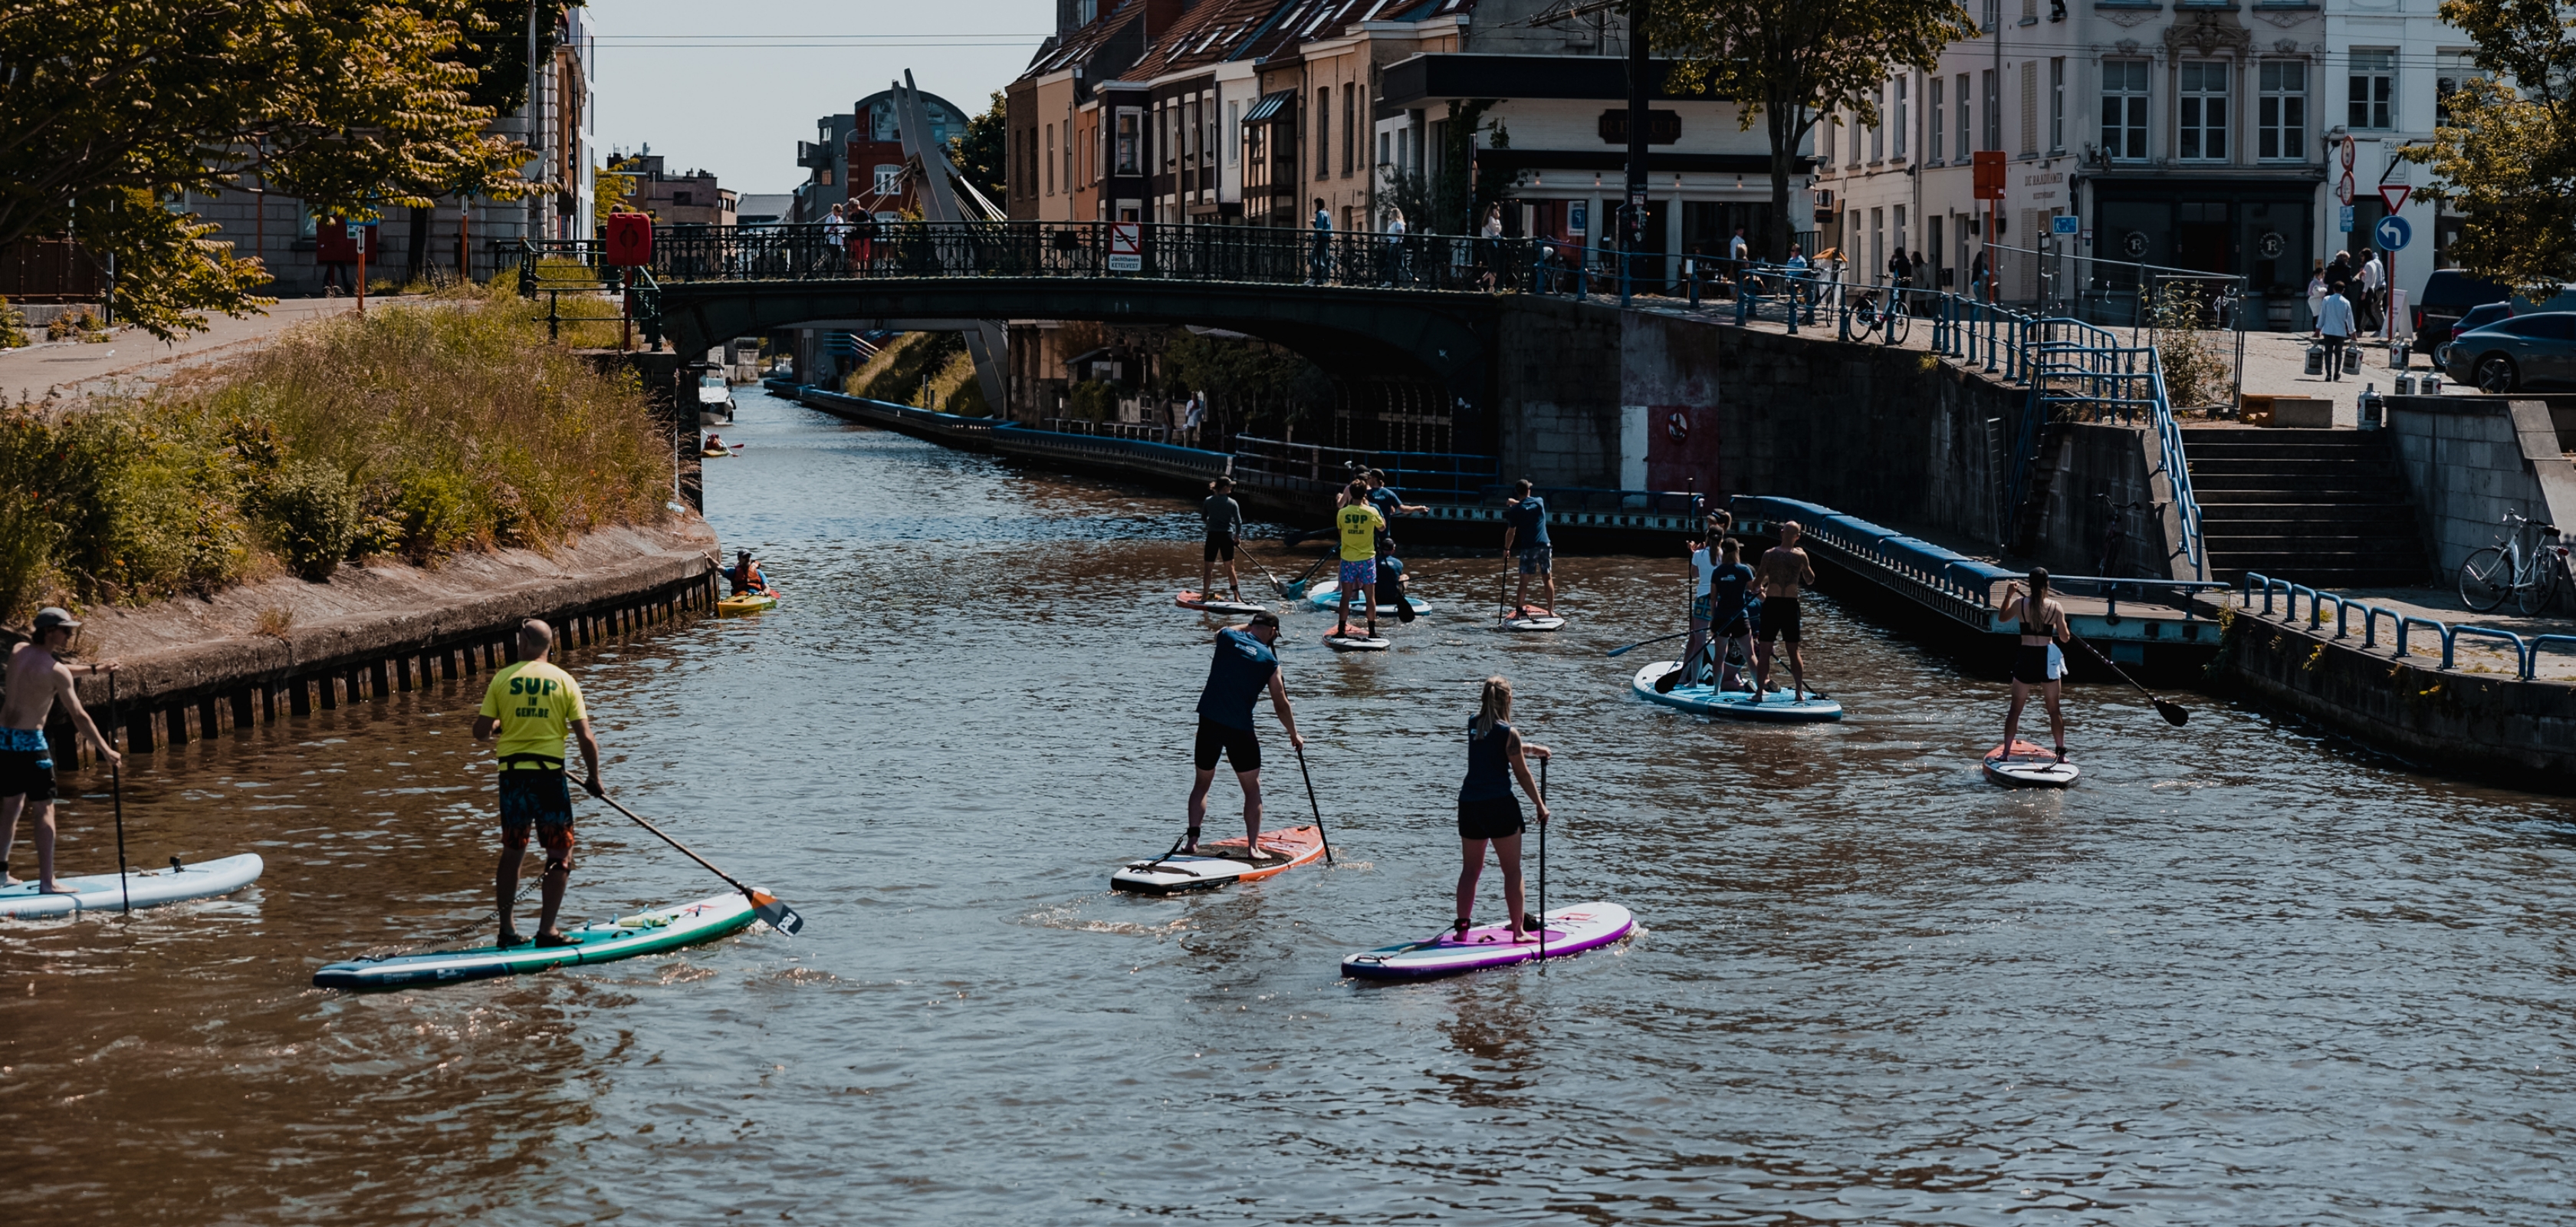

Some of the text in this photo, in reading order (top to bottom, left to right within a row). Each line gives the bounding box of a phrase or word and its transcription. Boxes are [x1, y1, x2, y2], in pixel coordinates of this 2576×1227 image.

[1602, 120, 1679, 133] REUE
[2025, 176, 2032, 186] DE
[1345, 514, 1368, 524] SUP
[510, 676, 558, 696] SUP
[528, 696, 537, 706] IN
[515, 707, 549, 718] GENT.BE
